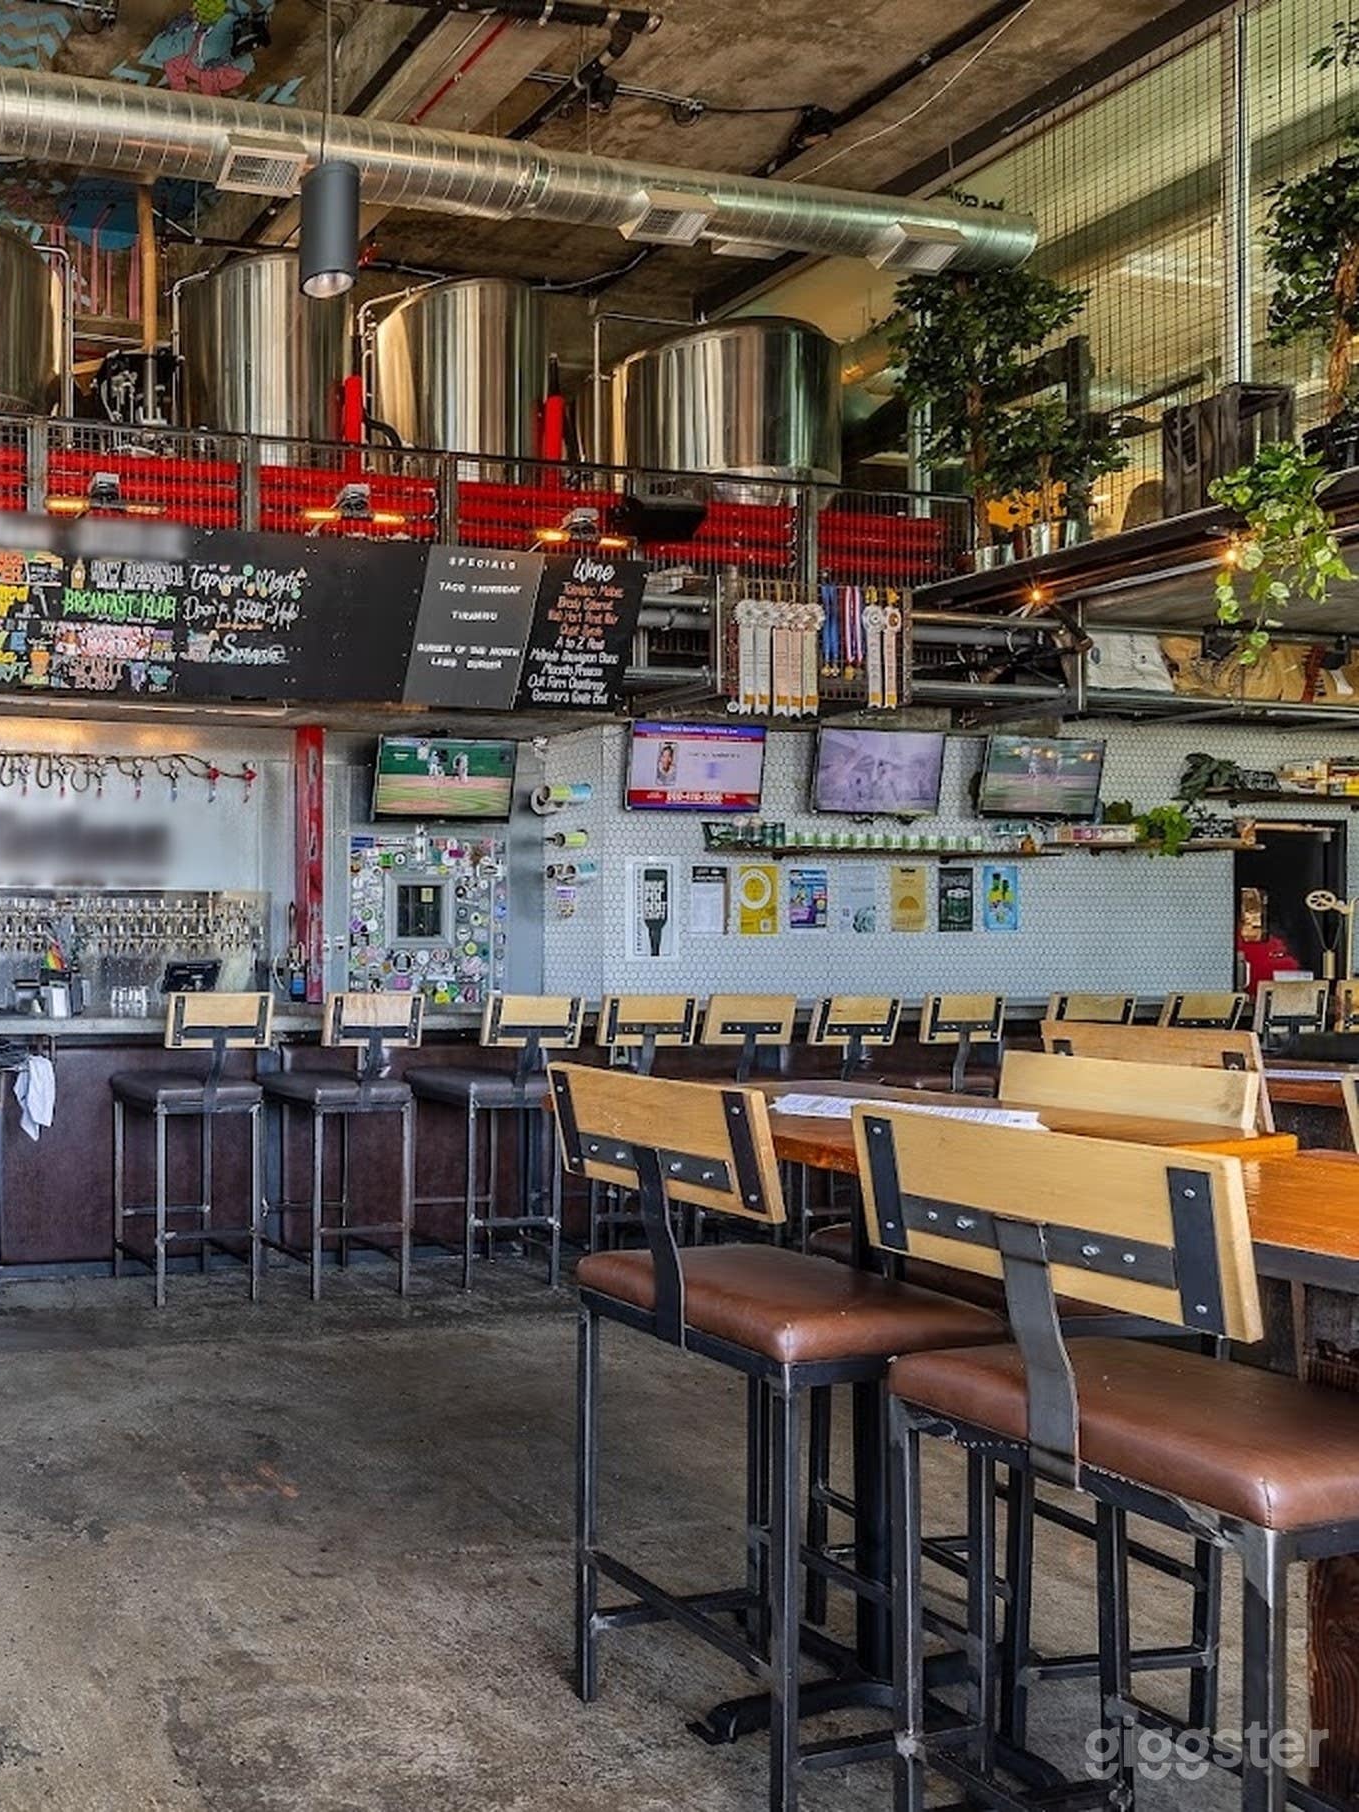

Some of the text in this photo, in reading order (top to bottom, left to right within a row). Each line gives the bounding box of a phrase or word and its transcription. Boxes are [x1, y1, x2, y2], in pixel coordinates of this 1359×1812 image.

[448, 556, 516, 571] SPECIALS
[572, 557, 616, 583] Wine
[439, 581, 466, 593] TACO
[454, 645, 467, 655] OF
